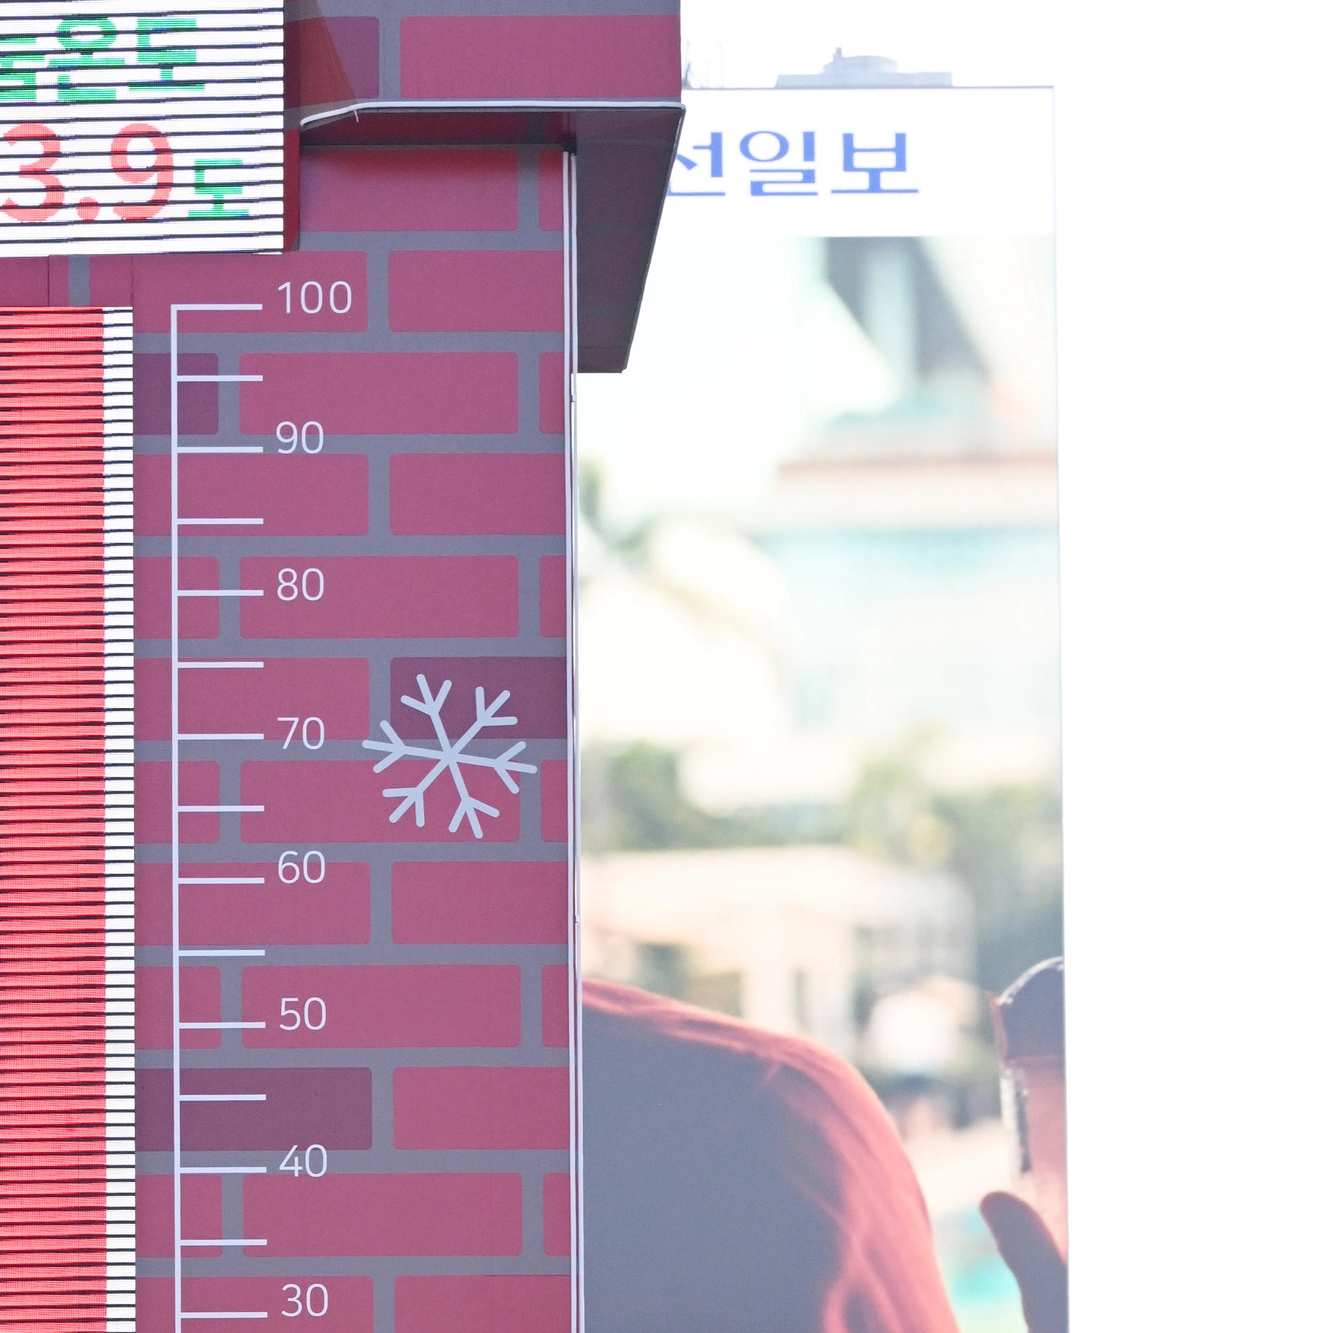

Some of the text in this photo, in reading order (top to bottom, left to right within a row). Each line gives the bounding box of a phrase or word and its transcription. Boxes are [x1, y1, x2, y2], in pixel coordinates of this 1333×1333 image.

[276, 281, 352, 314] 100
[275, 421, 325, 454] 90
[276, 568, 325, 601] 80
[277, 717, 325, 750] 70
[277, 850, 326, 884] 60
[279, 997, 327, 1031] 50
[279, 1144, 328, 1178] 40
[281, 1283, 329, 1317] 30
